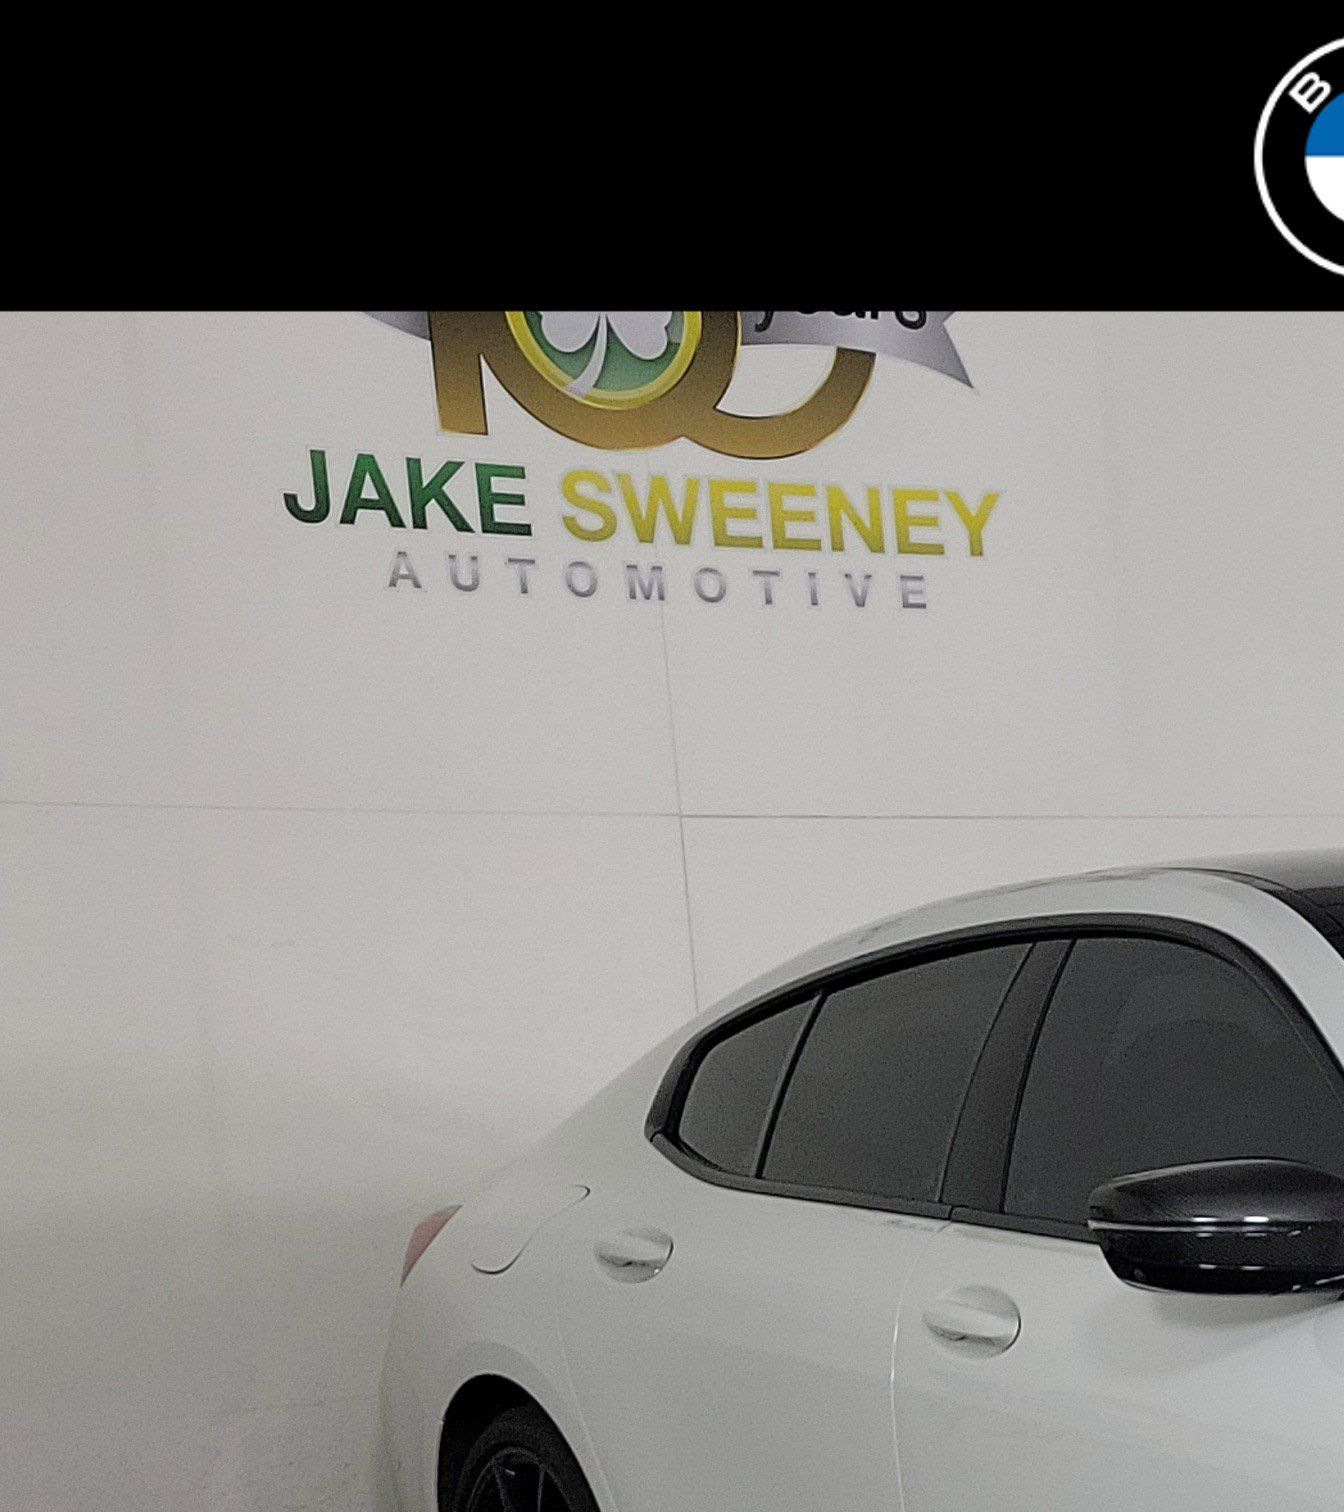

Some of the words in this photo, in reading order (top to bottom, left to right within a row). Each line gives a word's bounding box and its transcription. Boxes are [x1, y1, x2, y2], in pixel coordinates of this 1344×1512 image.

[283, 449, 533, 537] JAKE
[560, 469, 1001, 557] SWEENEY
[388, 551, 927, 609] AUTOMOTIVE
